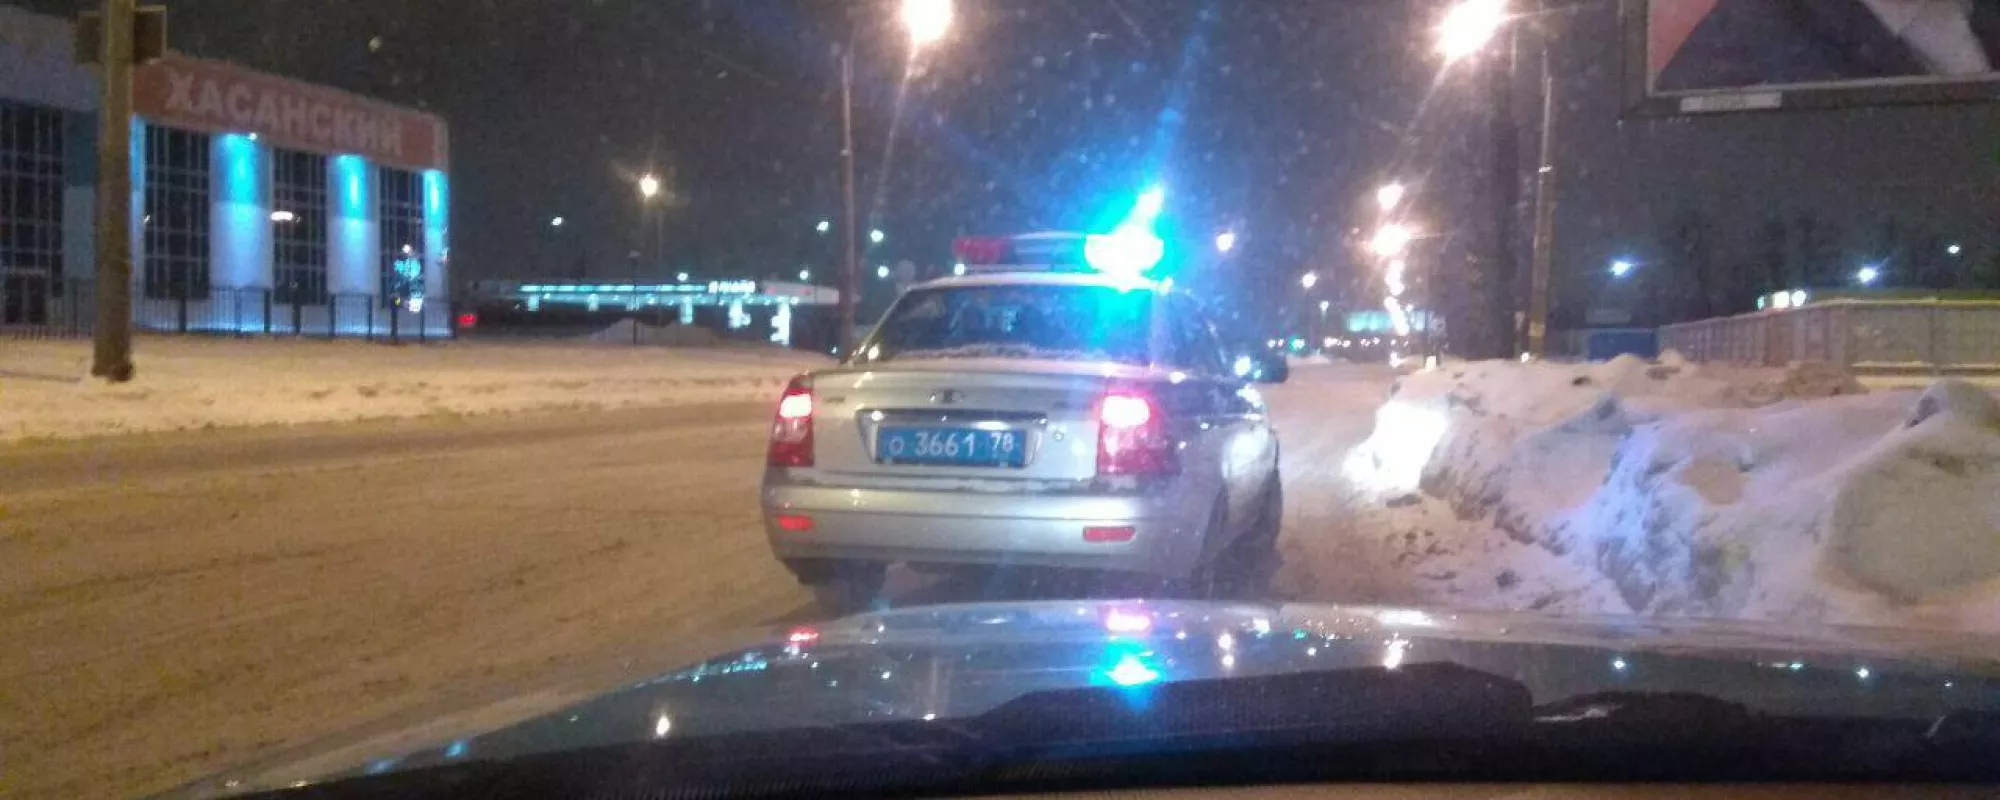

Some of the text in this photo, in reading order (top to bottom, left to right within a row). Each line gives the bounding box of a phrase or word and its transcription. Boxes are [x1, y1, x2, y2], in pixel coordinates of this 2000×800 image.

[164, 67, 402, 157] ХАСАНСКИЙ
[914, 430, 976, 458] 3661
[990, 432, 1014, 452] 78
